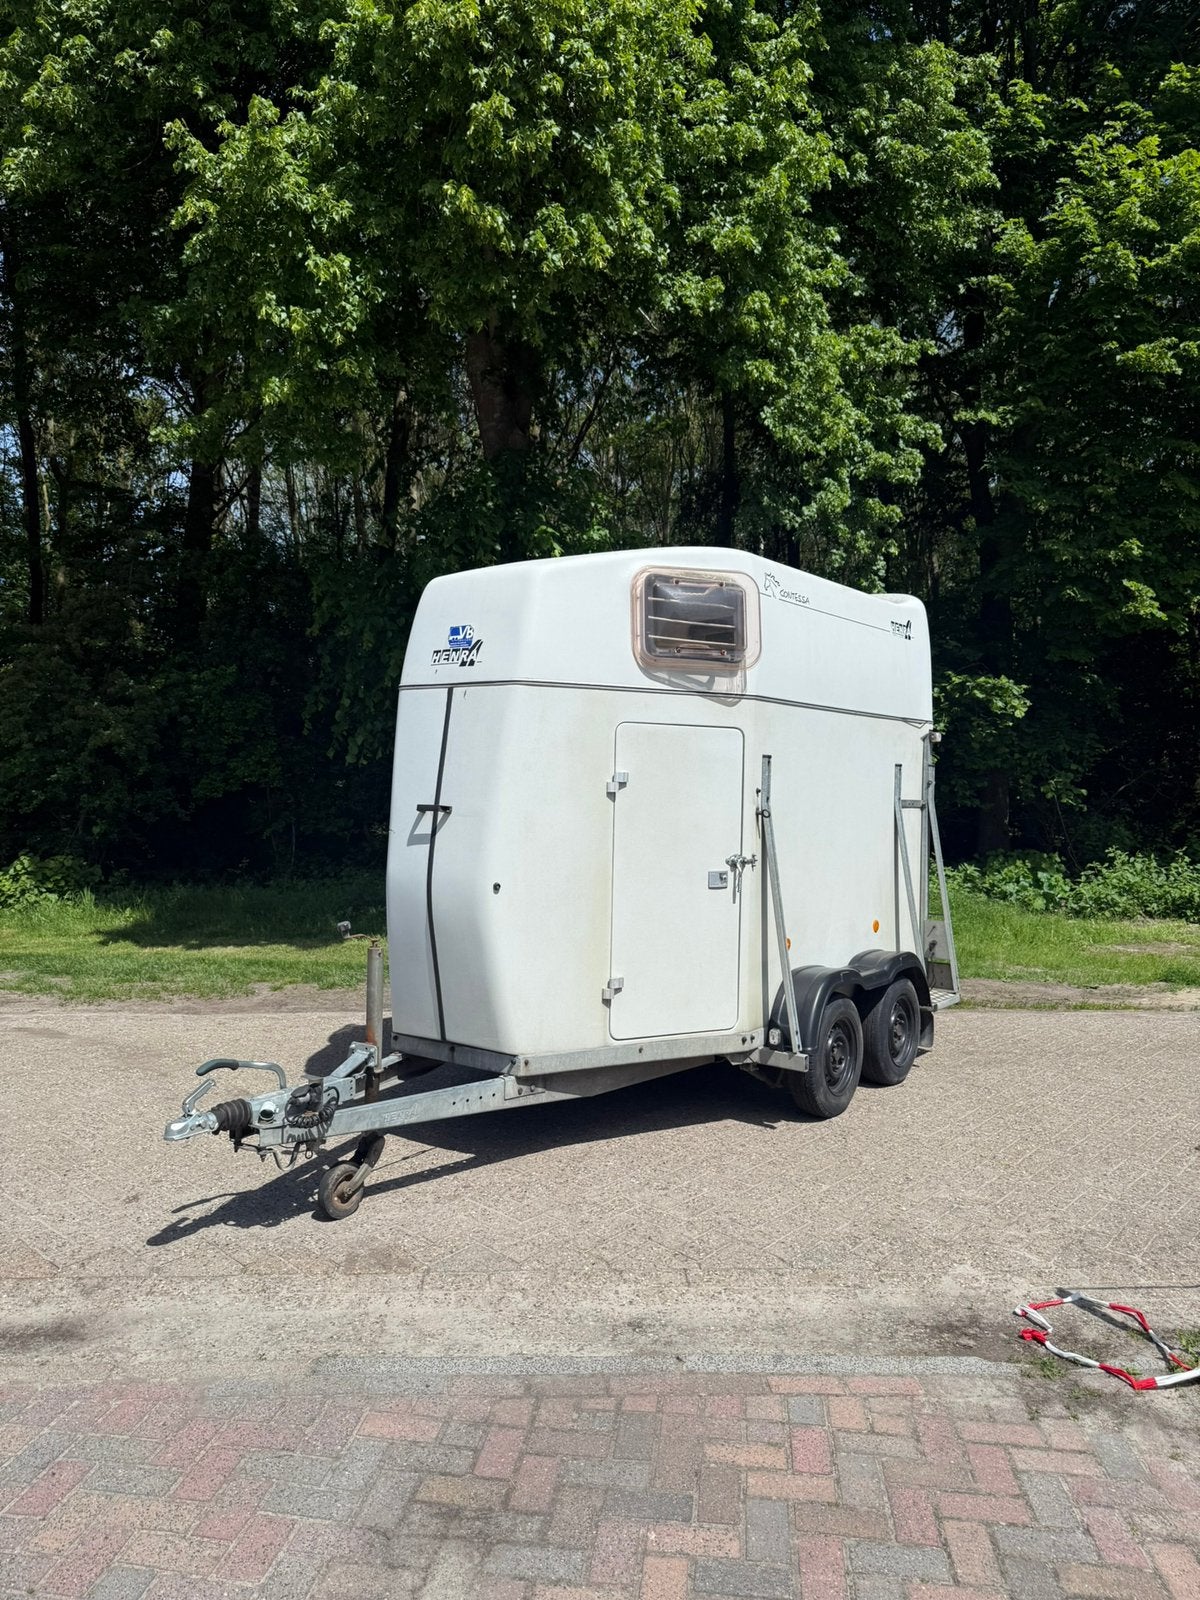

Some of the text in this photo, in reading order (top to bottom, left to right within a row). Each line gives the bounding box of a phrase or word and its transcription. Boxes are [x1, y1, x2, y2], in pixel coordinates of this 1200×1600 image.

[780, 589, 810, 604] CONTESSA
[459, 625, 474, 639] VB
[431, 639, 483, 667] HENRA
